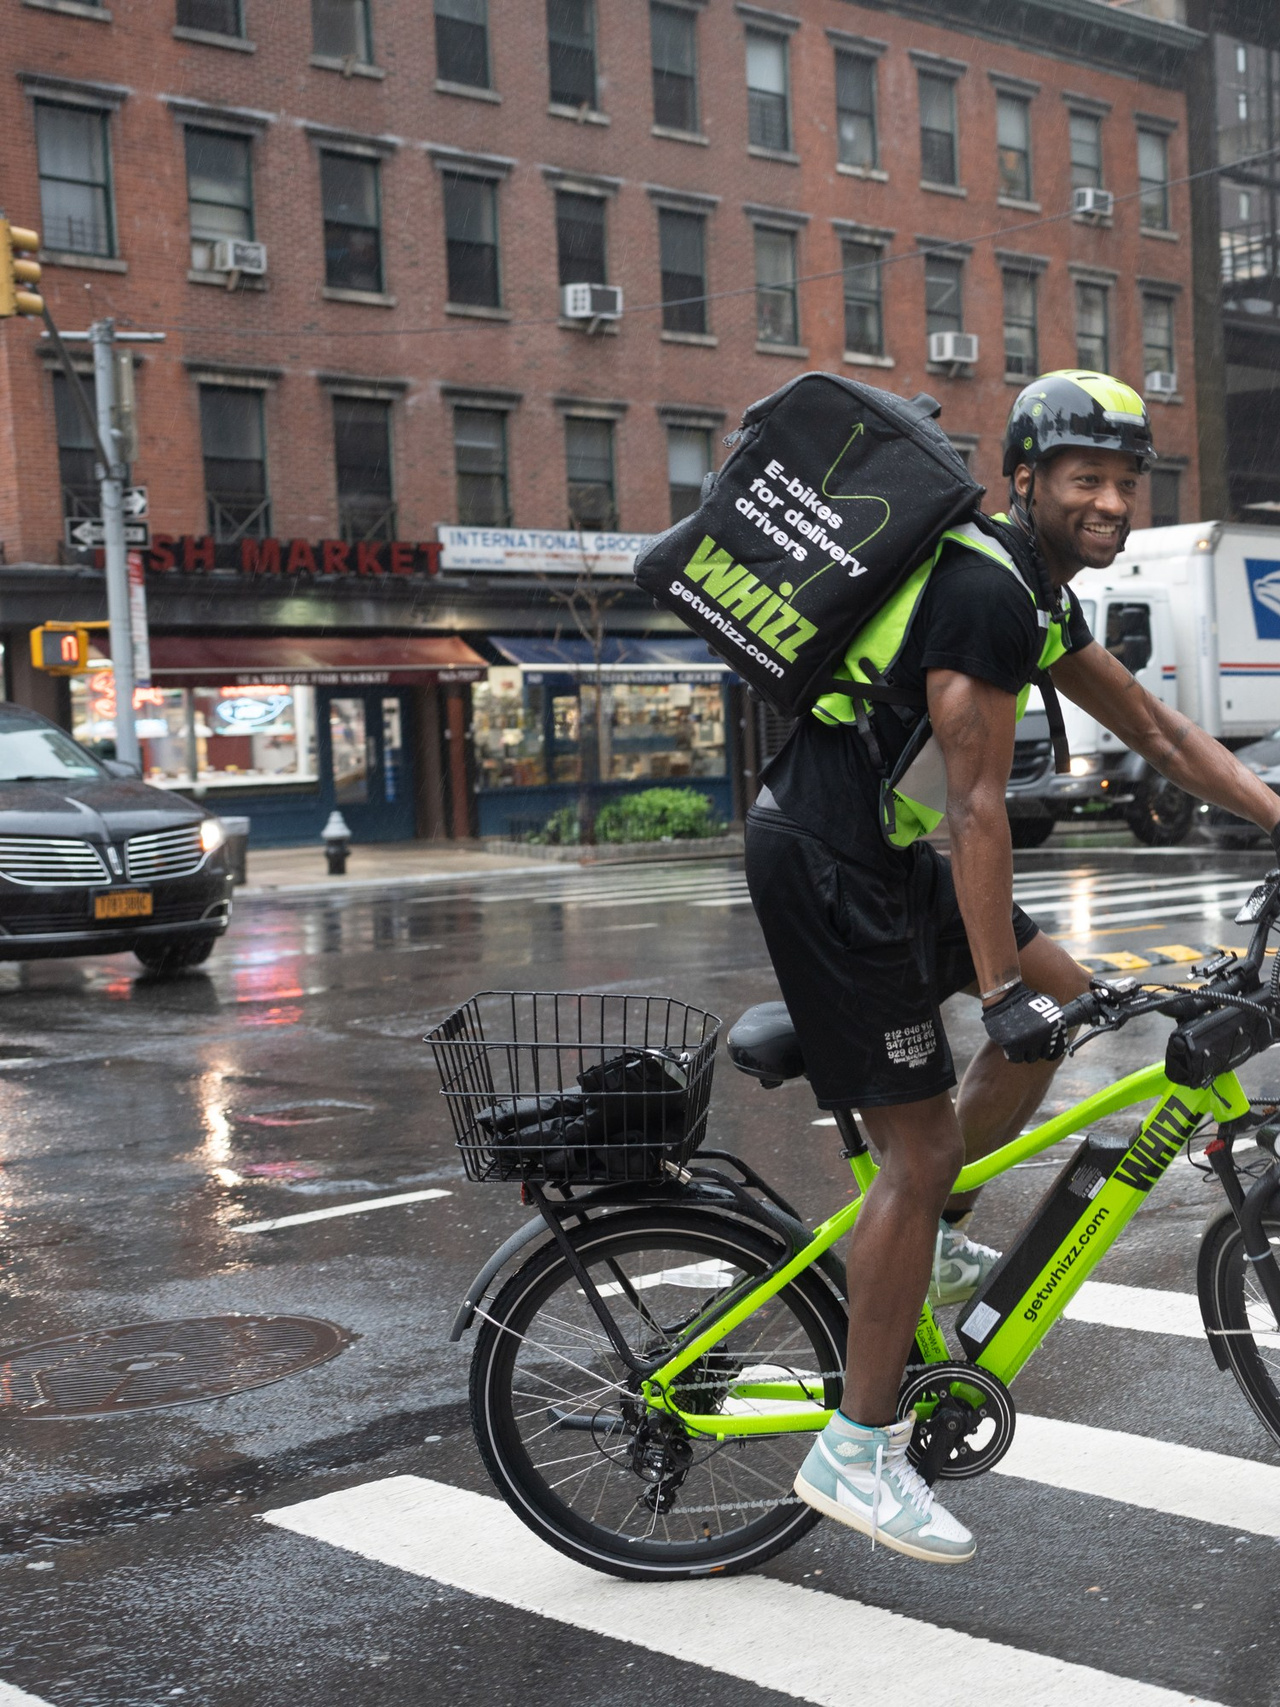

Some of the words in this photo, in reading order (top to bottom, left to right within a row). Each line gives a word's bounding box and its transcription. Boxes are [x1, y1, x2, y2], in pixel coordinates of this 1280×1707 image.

[764, 459, 843, 530] E-bikes
[241, 538, 444, 576] MARKET
[449, 531, 589, 551] INTERNATIONAL
[734, 498, 809, 562] drivers
[748, 477, 785, 510] for
[784, 507, 868, 578] delivery
[668, 579, 786, 679] getwhizz.com
[884, 1029, 902, 1041] 212
[904, 1024, 920, 1035] 646
[921, 1020, 933, 1030] 917
[886, 1038, 904, 1050] 347
[906, 1034, 922, 1046] 718
[887, 1049, 906, 1060] 929
[908, 1044, 923, 1056] 631
[1113, 1095, 1204, 1192] WHIZZ
[1023, 1206, 1110, 1323] getwhizz.com
